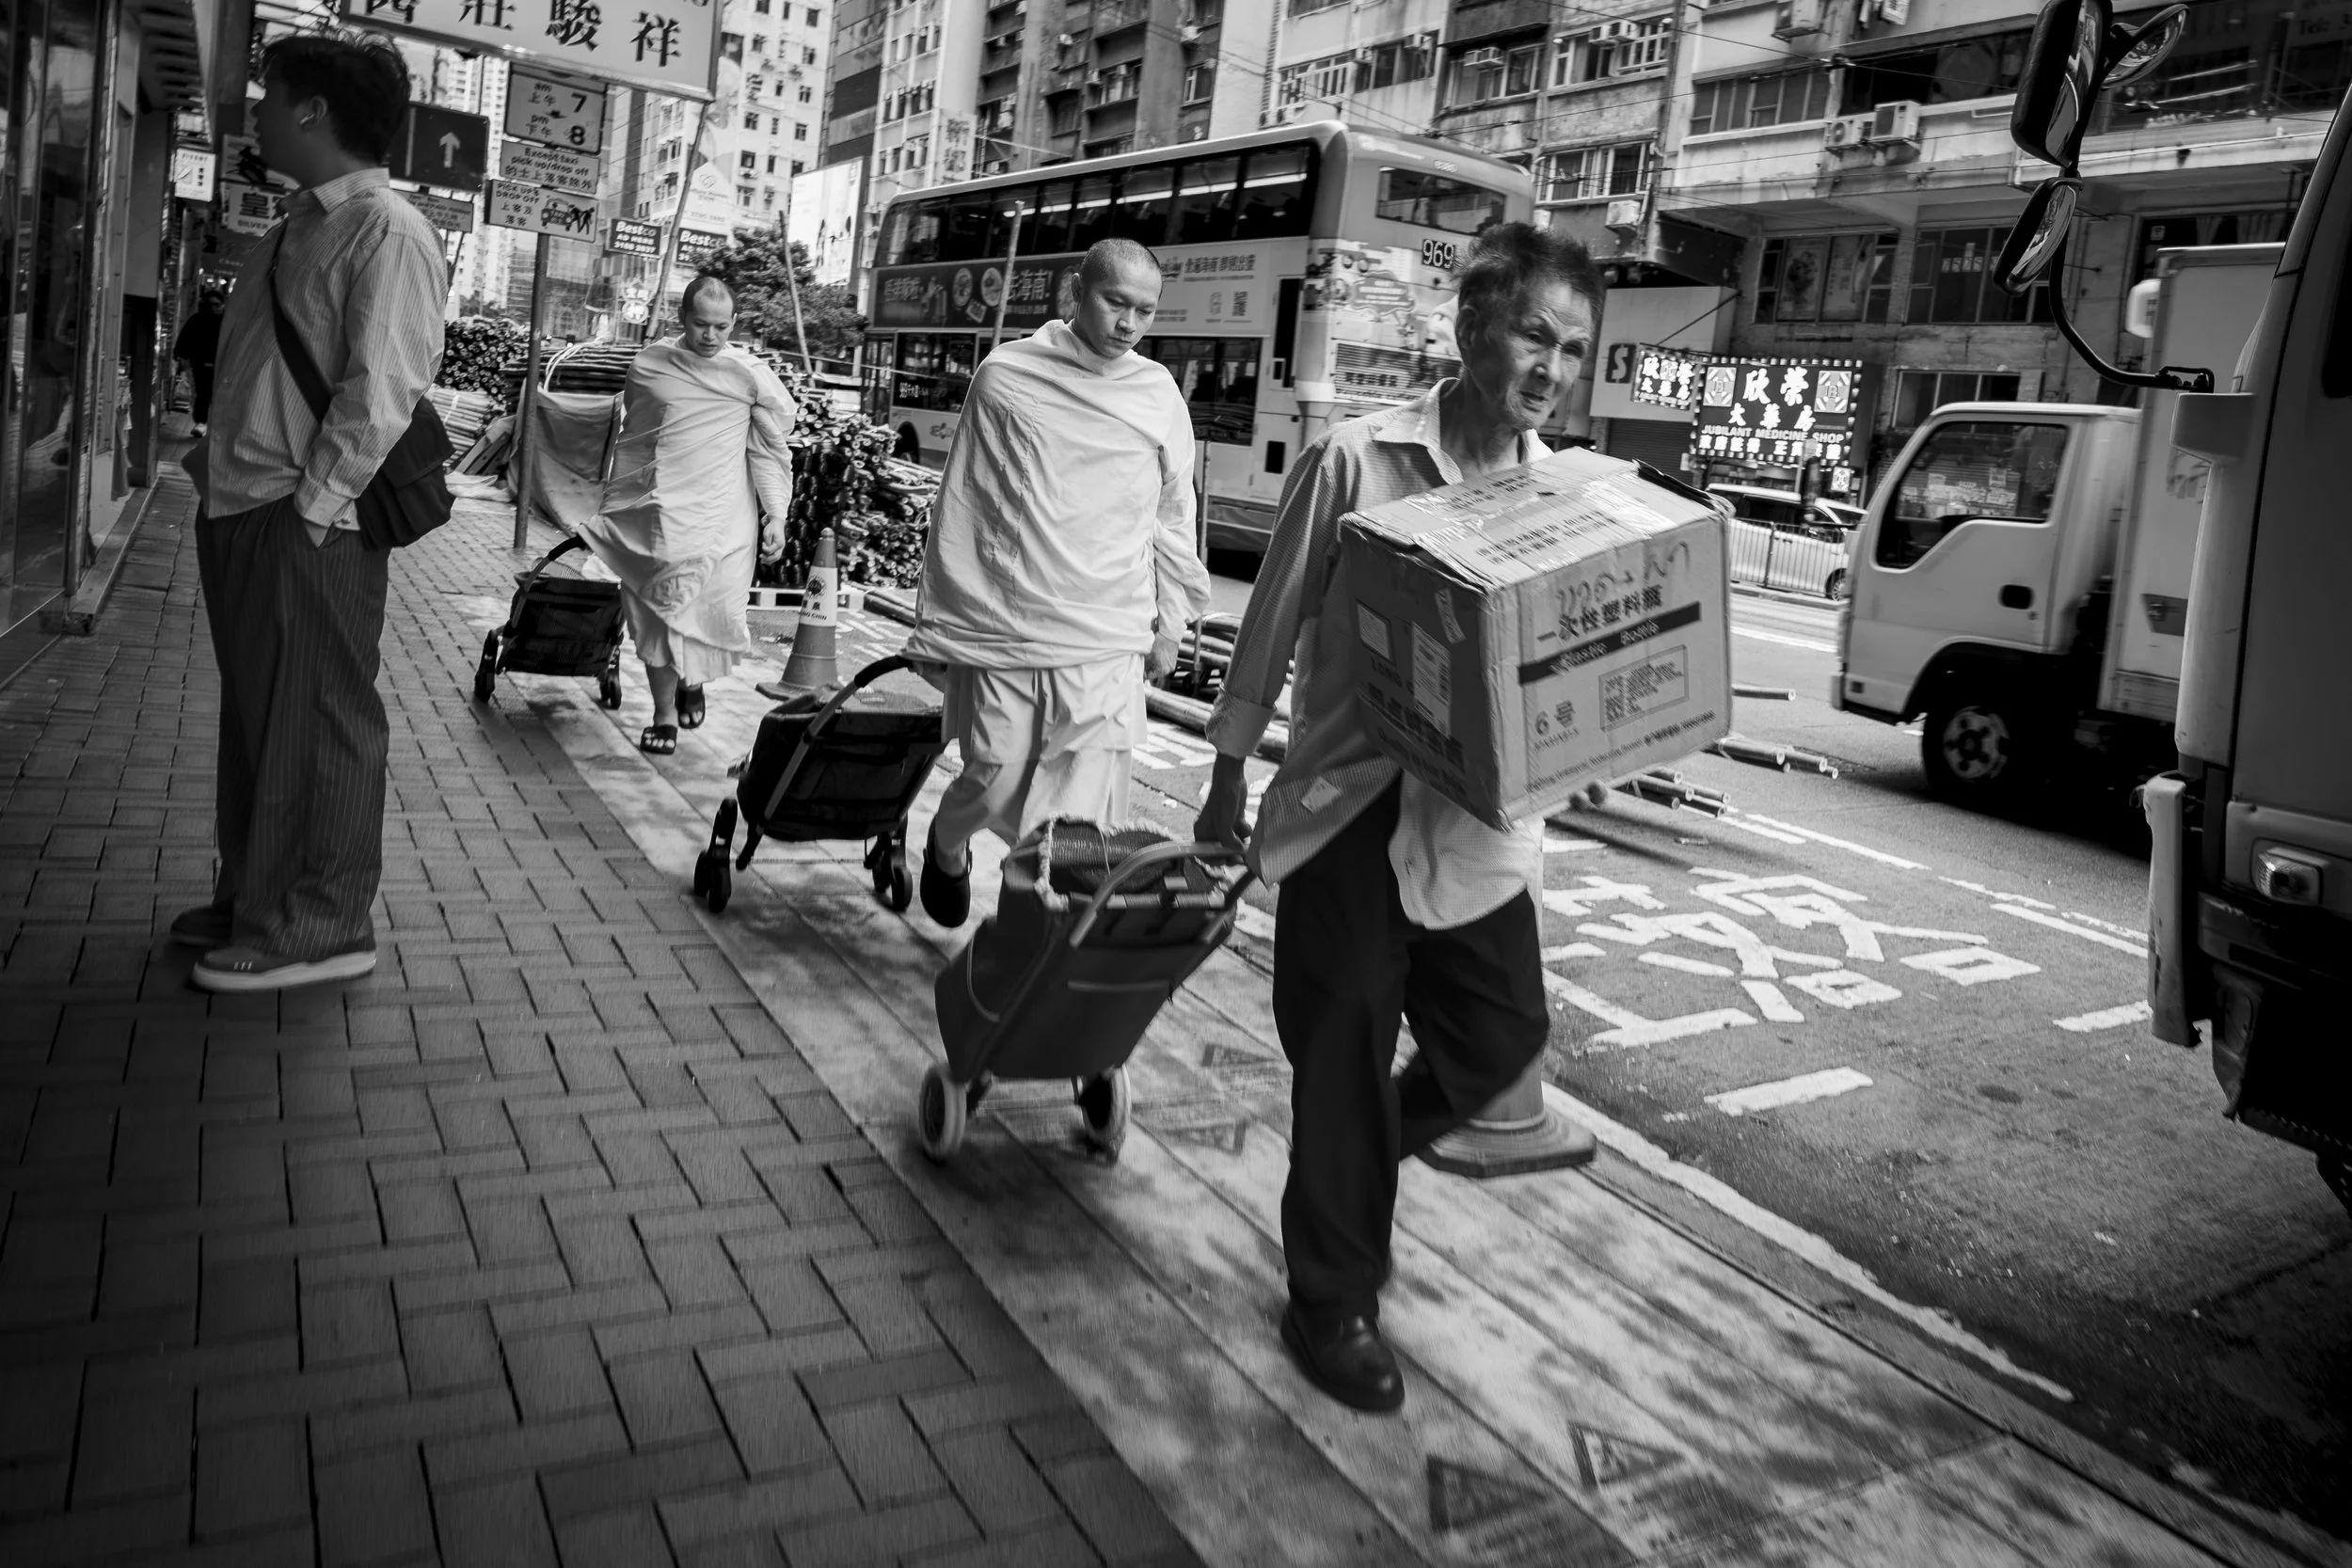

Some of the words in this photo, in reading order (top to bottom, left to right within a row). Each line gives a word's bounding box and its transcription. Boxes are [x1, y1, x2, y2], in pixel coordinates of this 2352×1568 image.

[534, 83, 552, 92] am
[528, 92, 556, 106] 上午
[571, 92, 587, 113] 7
[531, 114, 549, 125] pm
[526, 123, 553, 138] 下午
[570, 125, 586, 146] 8
[524, 147, 559, 162] Except
[560, 154, 580, 166] taxi
[511, 155, 532, 166] pick
[575, 166, 590, 177] off
[496, 190, 521, 200] DROP
[523, 195, 540, 204] OFF
[615, 220, 657, 237] Bestco
[1423, 239, 1454, 269] 969
[1701, 425, 1753, 438] JUBILANT
[1755, 428, 1808, 442] MEDICINE
[1811, 432, 1845, 444] SHOP
